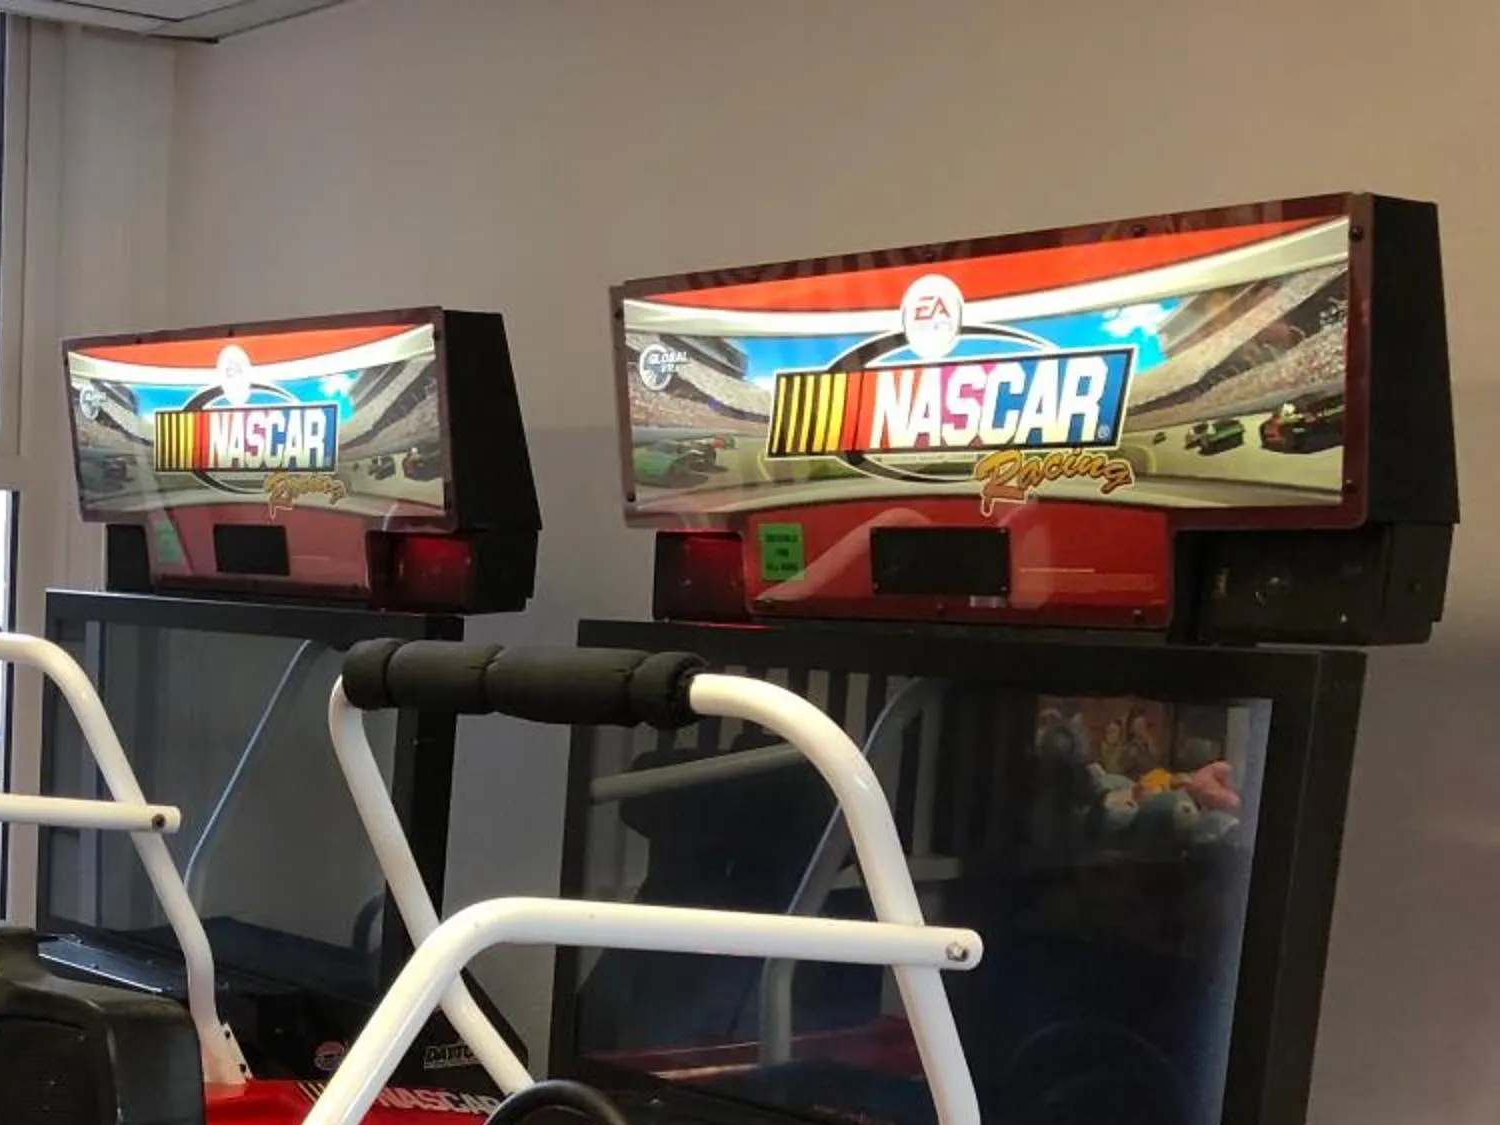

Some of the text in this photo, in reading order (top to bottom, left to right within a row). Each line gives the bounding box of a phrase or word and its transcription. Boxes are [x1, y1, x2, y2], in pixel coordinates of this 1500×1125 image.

[915, 296, 950, 320] EA
[869, 354, 1108, 450] NASCAR
[209, 408, 327, 469] NASCAR
[974, 448, 1135, 517] Racing
